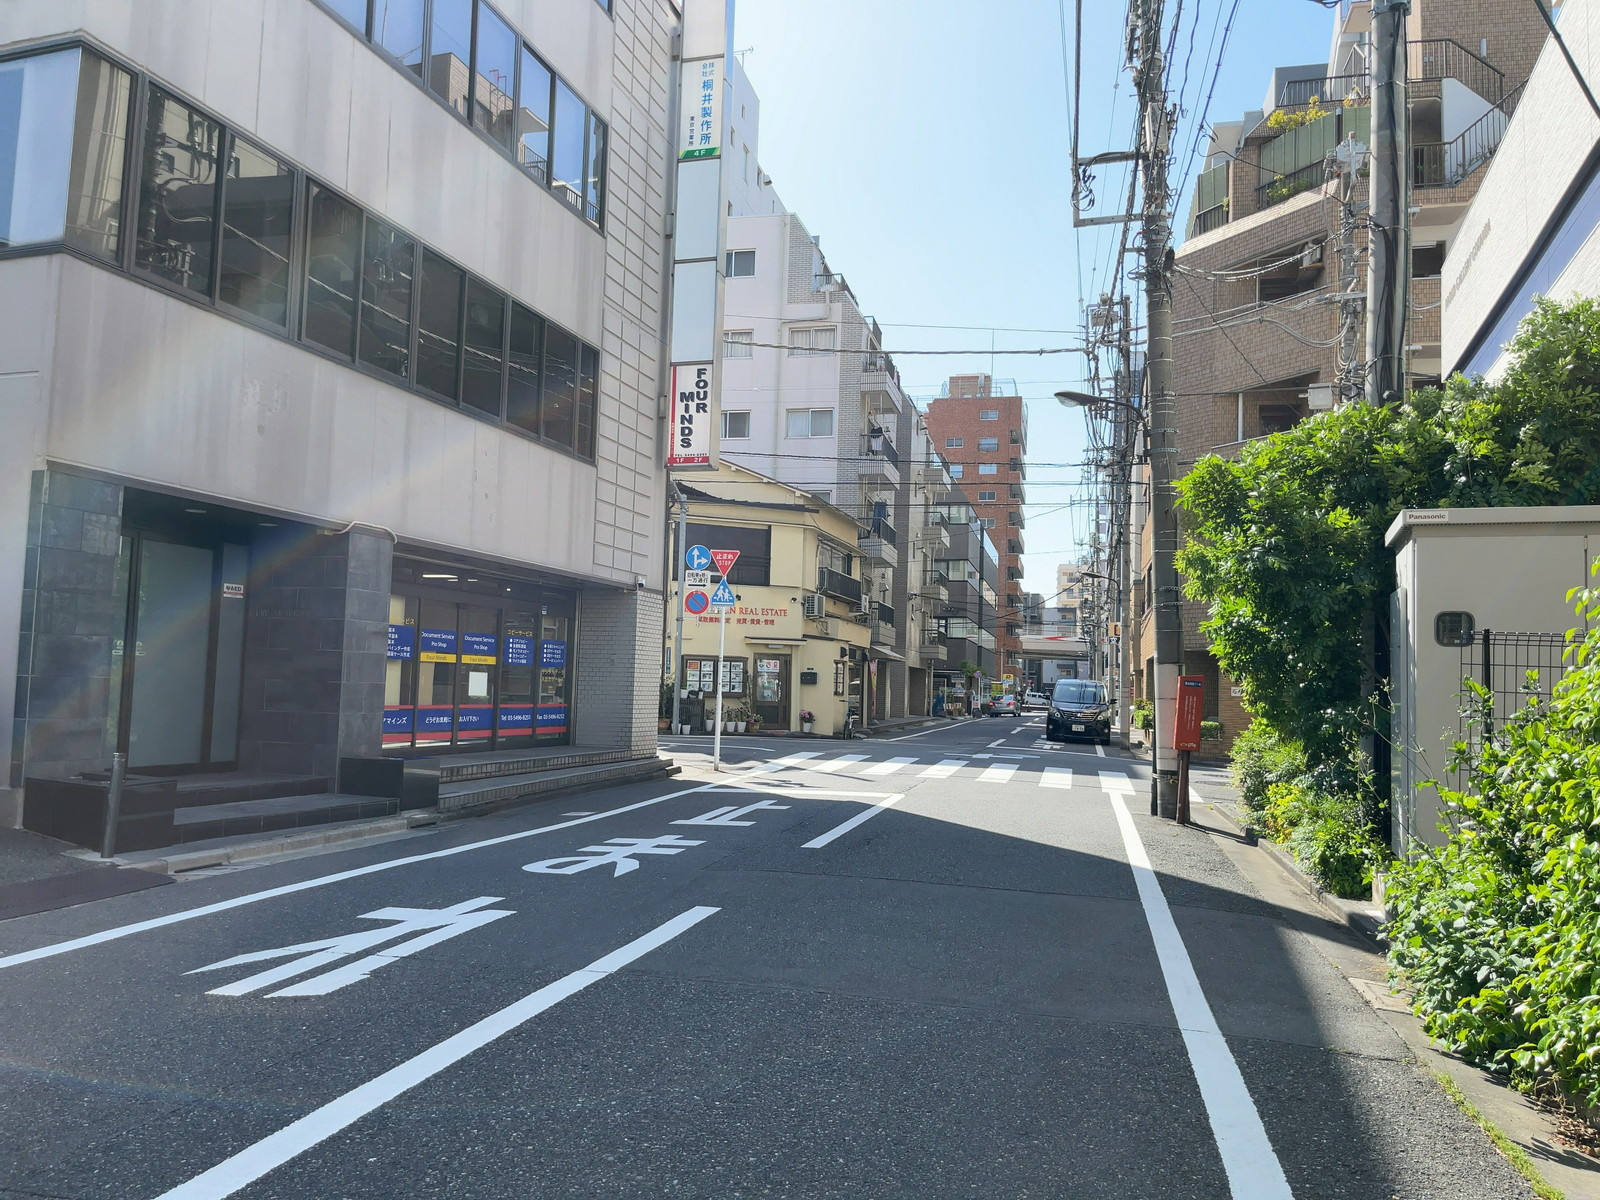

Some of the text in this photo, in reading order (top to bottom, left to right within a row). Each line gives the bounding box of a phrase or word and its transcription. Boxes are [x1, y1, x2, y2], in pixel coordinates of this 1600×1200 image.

[699, 79, 713, 145] 桐井製作所
[693, 149, 706, 157] 4F
[695, 368, 709, 413] FOUR
[680, 391, 695, 449] MINDS
[508, 629, 533, 637] コピーサービス
[739, 607, 759, 615] REAL
[761, 608, 788, 617] ESTATE
[181, 800, 792, 998] 止まれ
